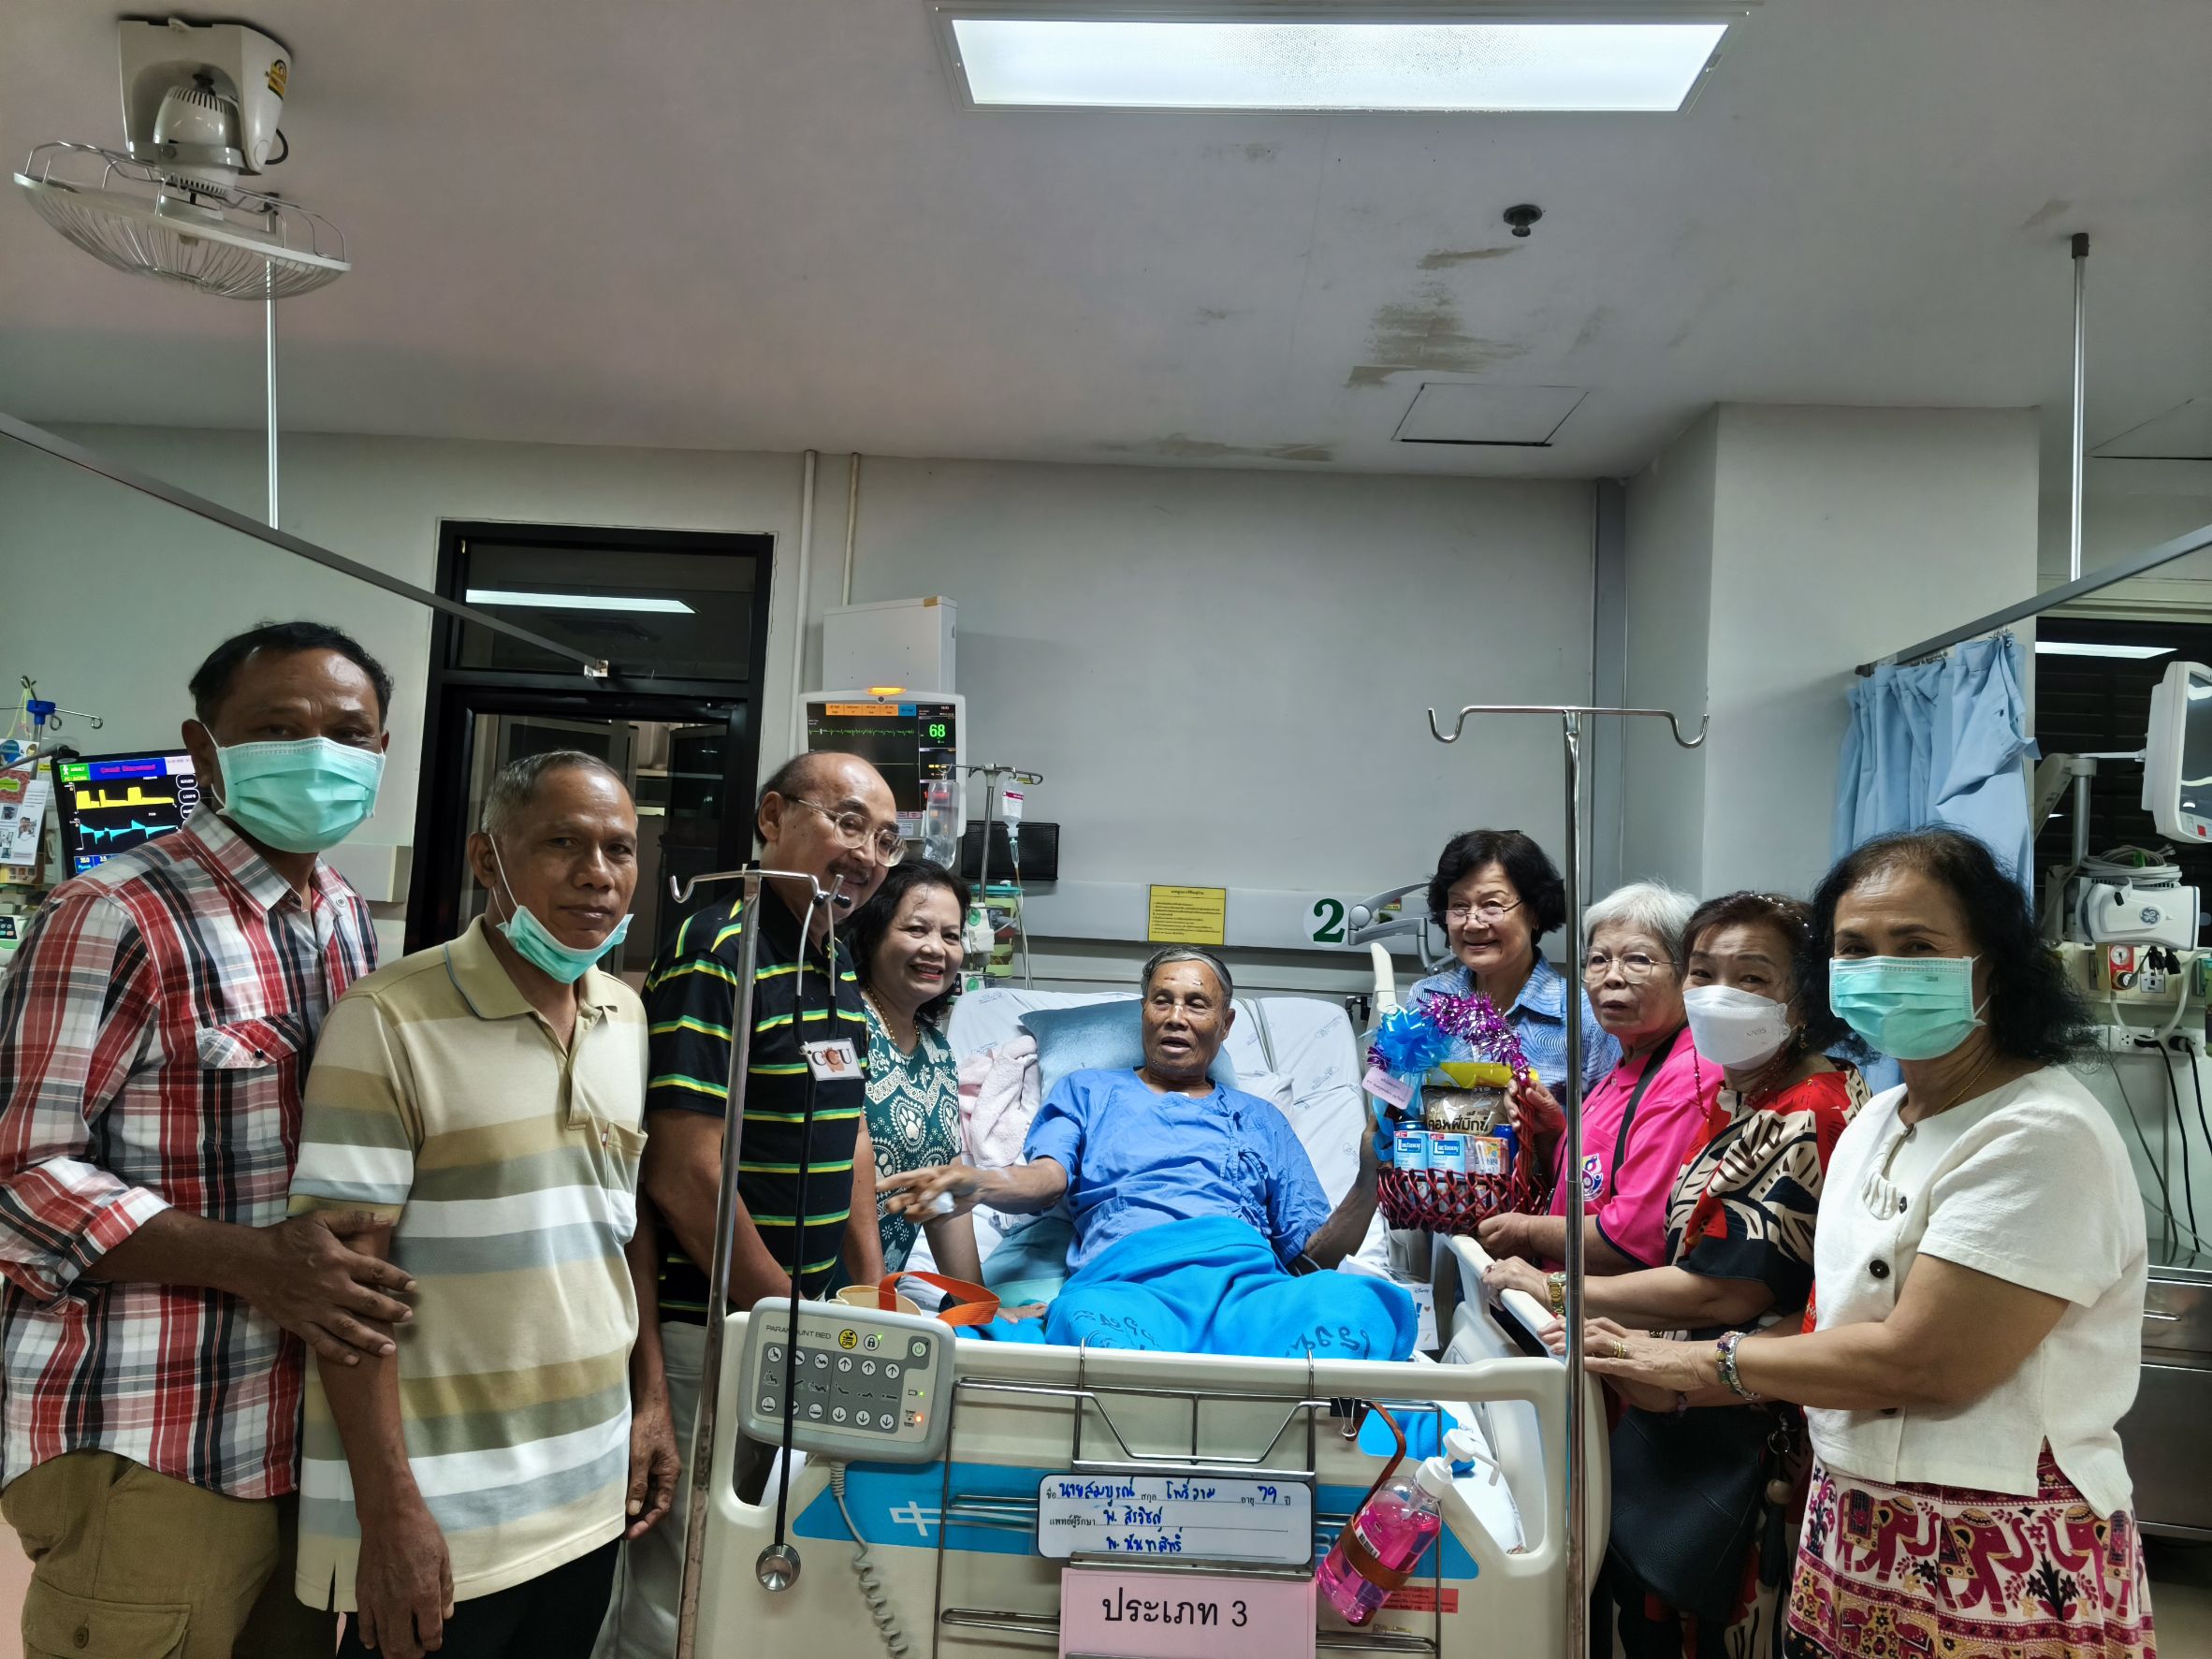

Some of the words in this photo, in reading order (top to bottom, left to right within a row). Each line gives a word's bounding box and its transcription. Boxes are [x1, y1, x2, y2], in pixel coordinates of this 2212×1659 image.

[929, 724, 946, 737] 68
[1313, 898, 1345, 943] 2
[812, 1049, 852, 1066] CCU
[1398, 1139, 1420, 1151] Lactasoy
[1434, 1142, 1459, 1154] Lactasoy
[766, 1325, 814, 1337] PARAUNT
[815, 1332, 832, 1340] BED
[1141, 1493, 1157, 1503] สกุล
[1241, 1497, 1255, 1506] อายุ
[1284, 1495, 1291, 1506] ปี
[1049, 1514, 1096, 1528] แพทย์ผู้รักษา
[1102, 1587, 1217, 1626] ประเภท
[1231, 1600, 1248, 1627] 3
